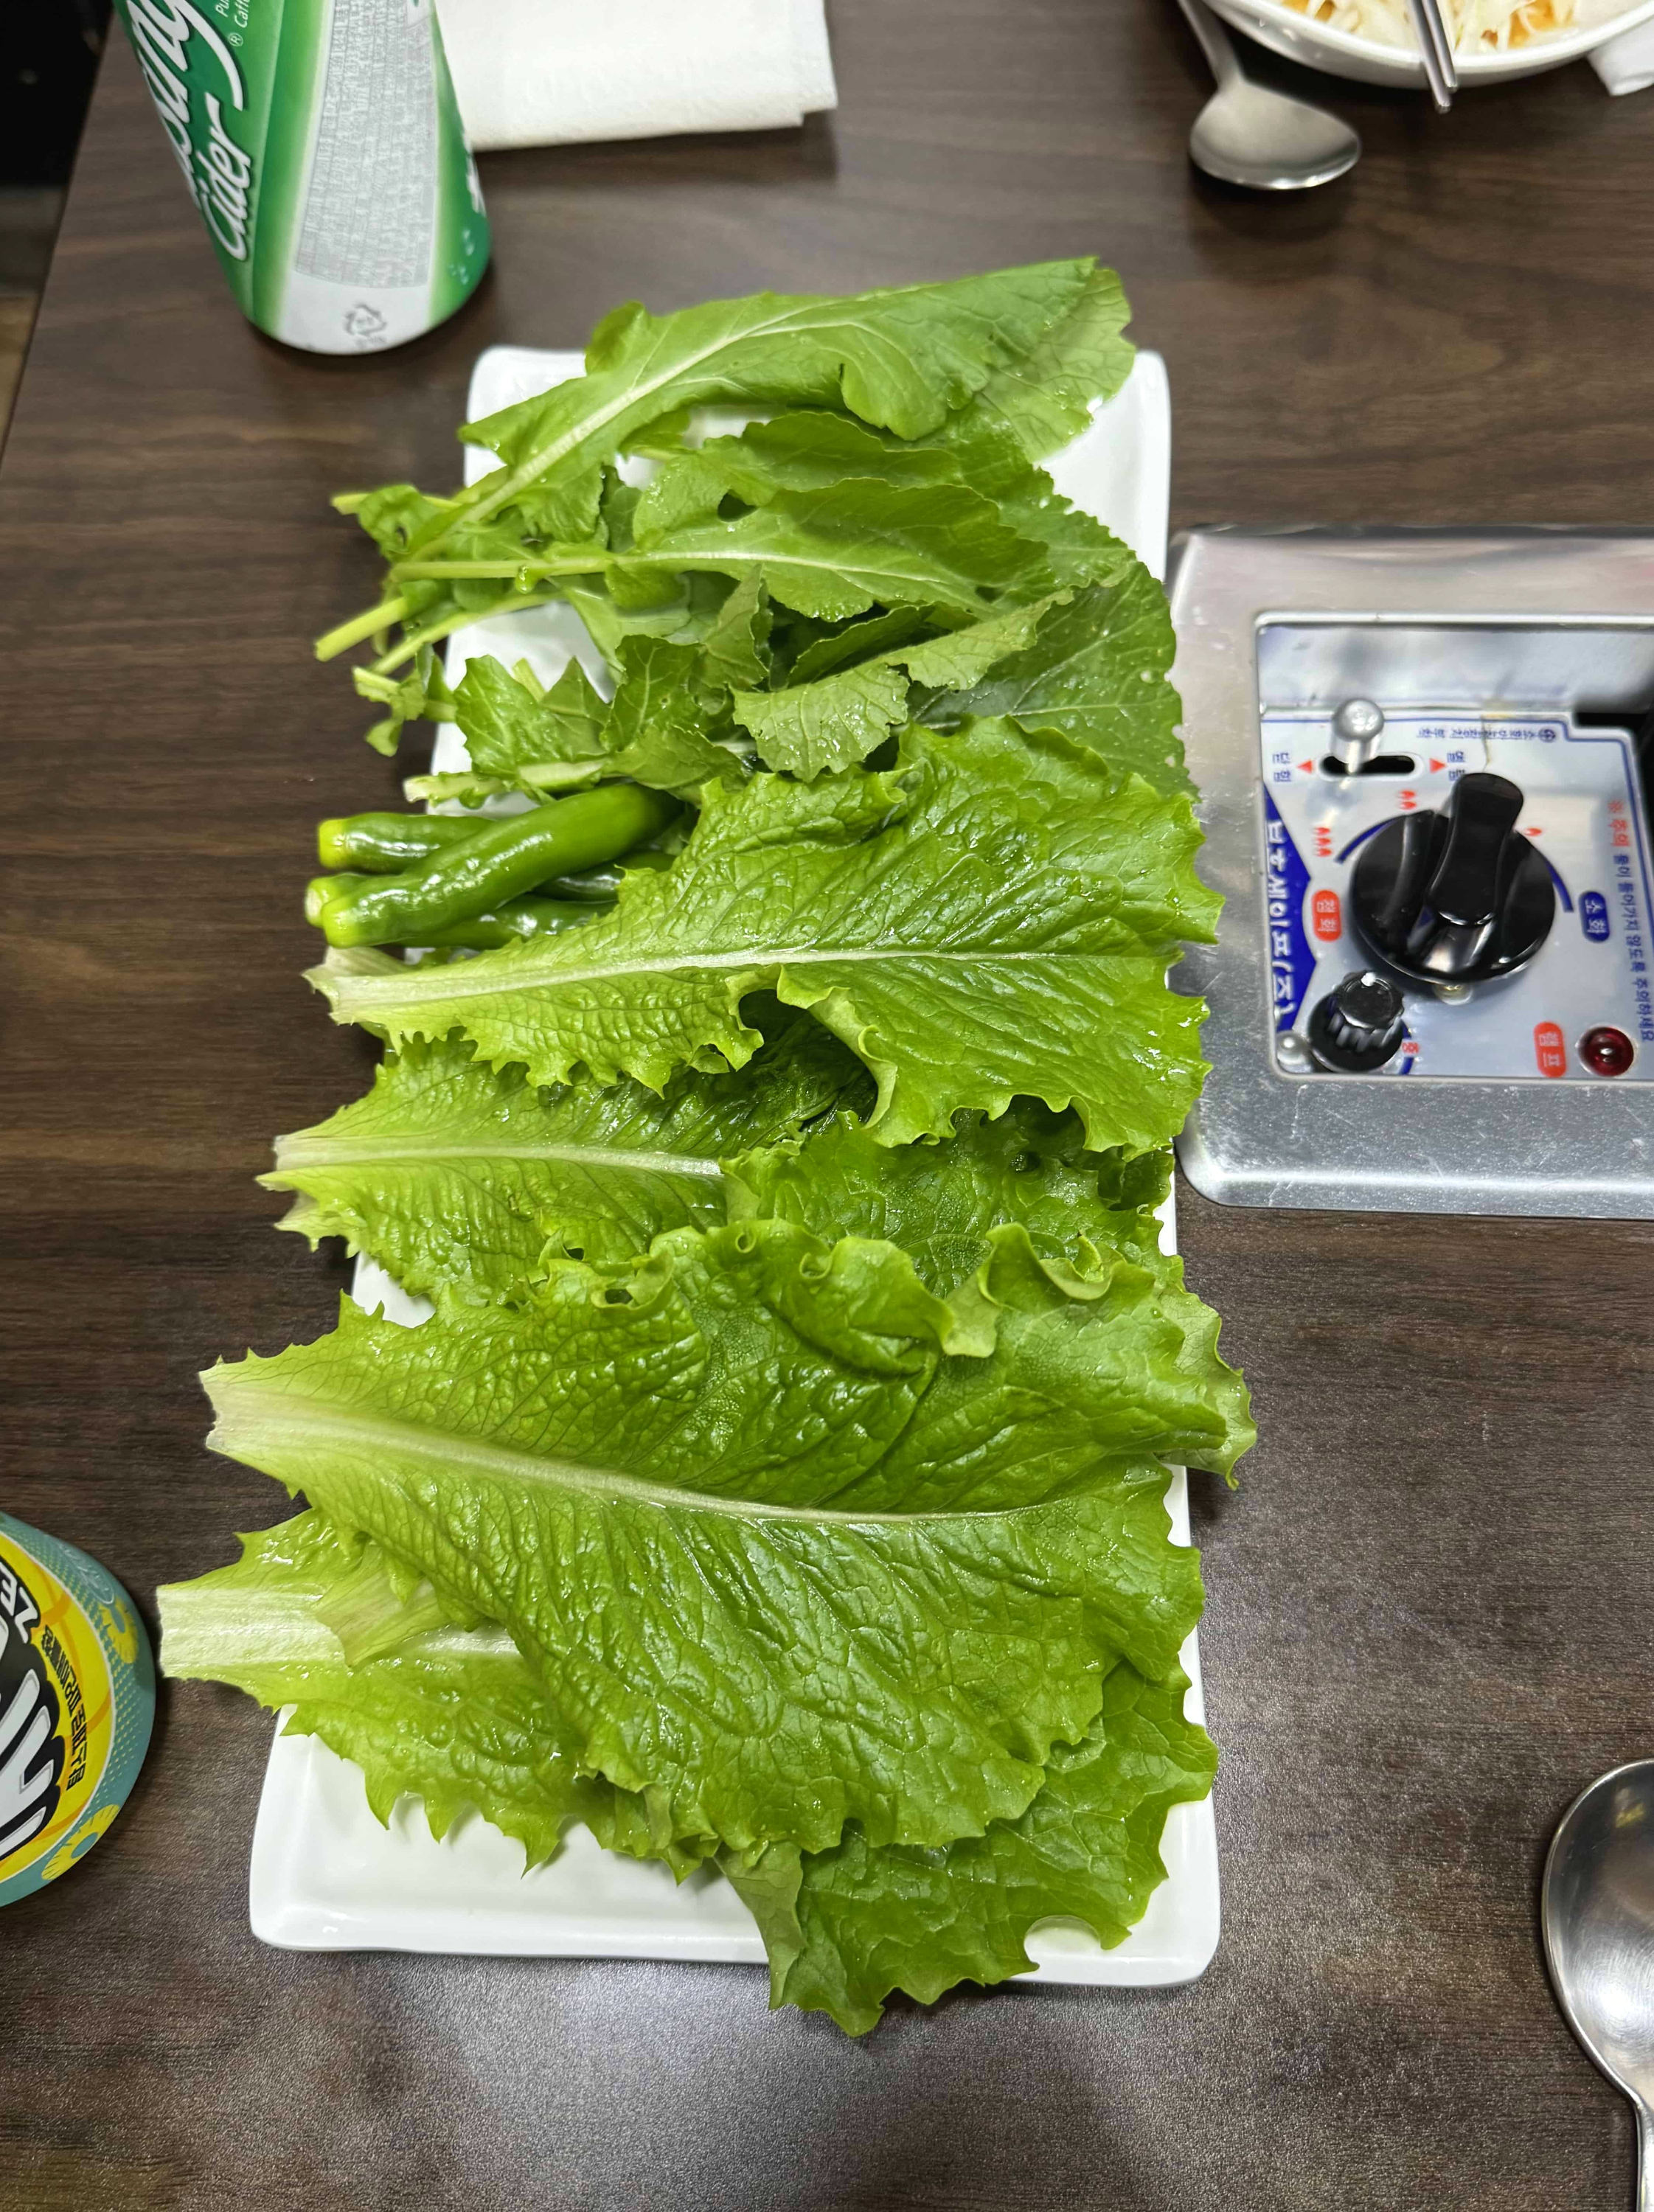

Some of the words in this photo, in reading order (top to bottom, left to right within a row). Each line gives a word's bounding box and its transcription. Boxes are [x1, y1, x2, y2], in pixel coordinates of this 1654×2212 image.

[234, 0, 251, 28] Caff
[196, 92, 251, 261] Cider
[1584, 899, 1606, 935] 소화
[1608, 818, 1631, 847] 주의
[1630, 977, 1654, 1043] 주의하세요
